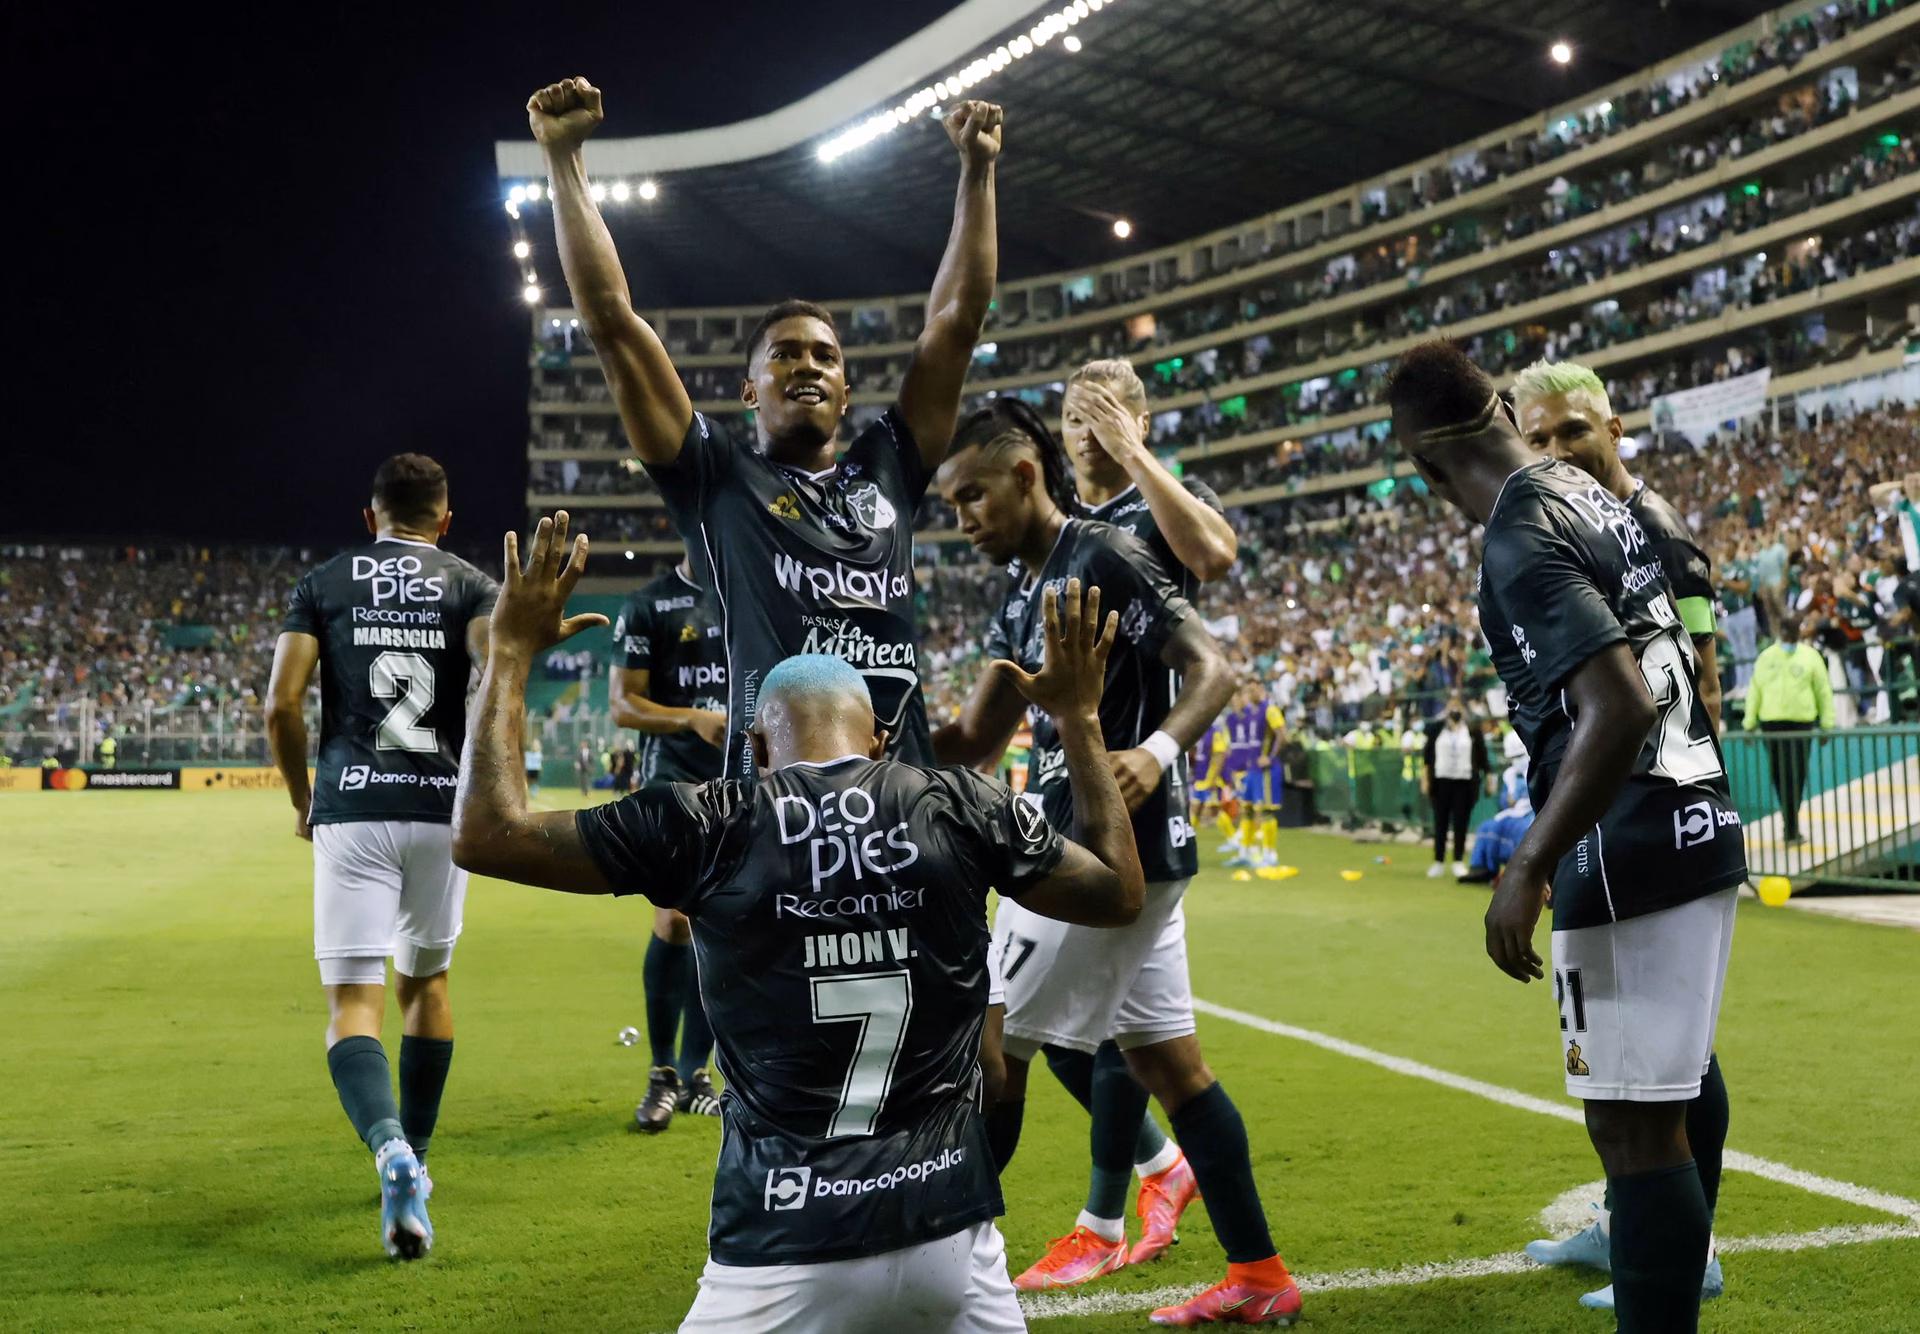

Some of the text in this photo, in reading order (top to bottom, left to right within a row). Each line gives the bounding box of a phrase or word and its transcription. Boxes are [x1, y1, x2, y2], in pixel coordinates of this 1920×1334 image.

[774, 552, 908, 606] Wplay.co
[353, 626, 447, 650] MARSIGLIA
[801, 615, 841, 631] PASTAS
[838, 618, 862, 642] La
[800, 626, 916, 669] Muñeca
[678, 661, 726, 689] Wpla
[369, 650, 440, 754] 2
[742, 669, 760, 775] Natural Sstems
[90, 772, 173, 786] mastercard
[228, 773, 284, 788] betfa
[1576, 836, 1589, 874] tems
[775, 885, 927, 920] Recamier
[803, 927, 919, 968] JHON V.
[809, 969, 914, 1140] 7
[813, 1147, 964, 1199] bancopopula
